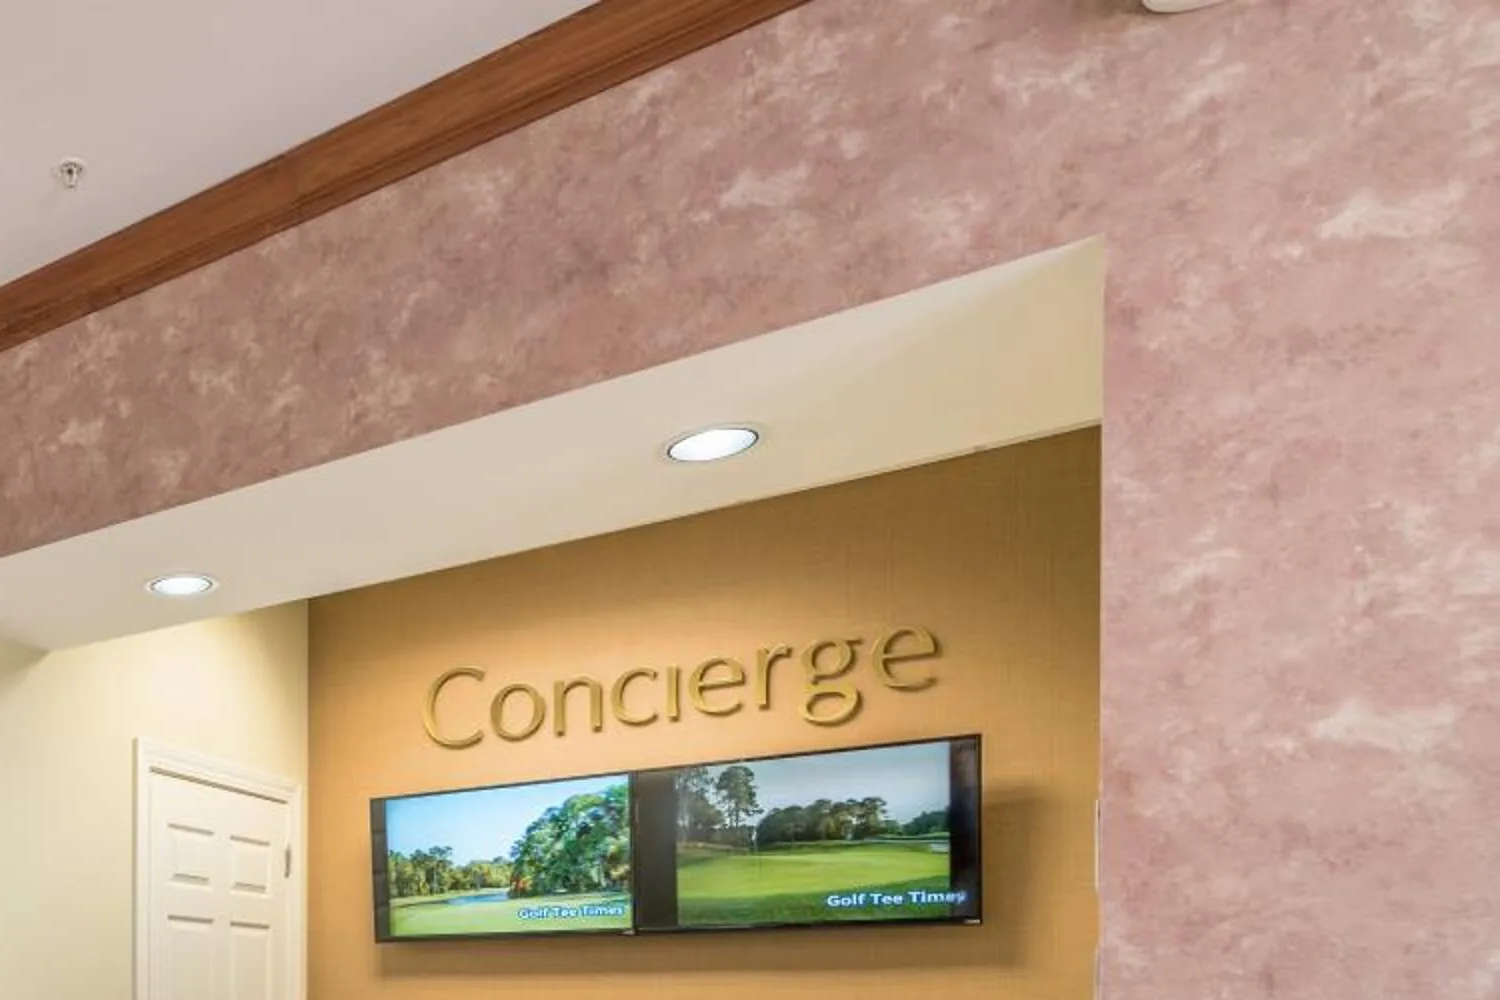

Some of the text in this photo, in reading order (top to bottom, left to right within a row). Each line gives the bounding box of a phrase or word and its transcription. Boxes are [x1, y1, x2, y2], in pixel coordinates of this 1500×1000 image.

[422, 624, 942, 750] Concierge
[826, 893, 866, 908] Golf
[869, 892, 903, 906] Tee
[517, 906, 549, 920] Golf
